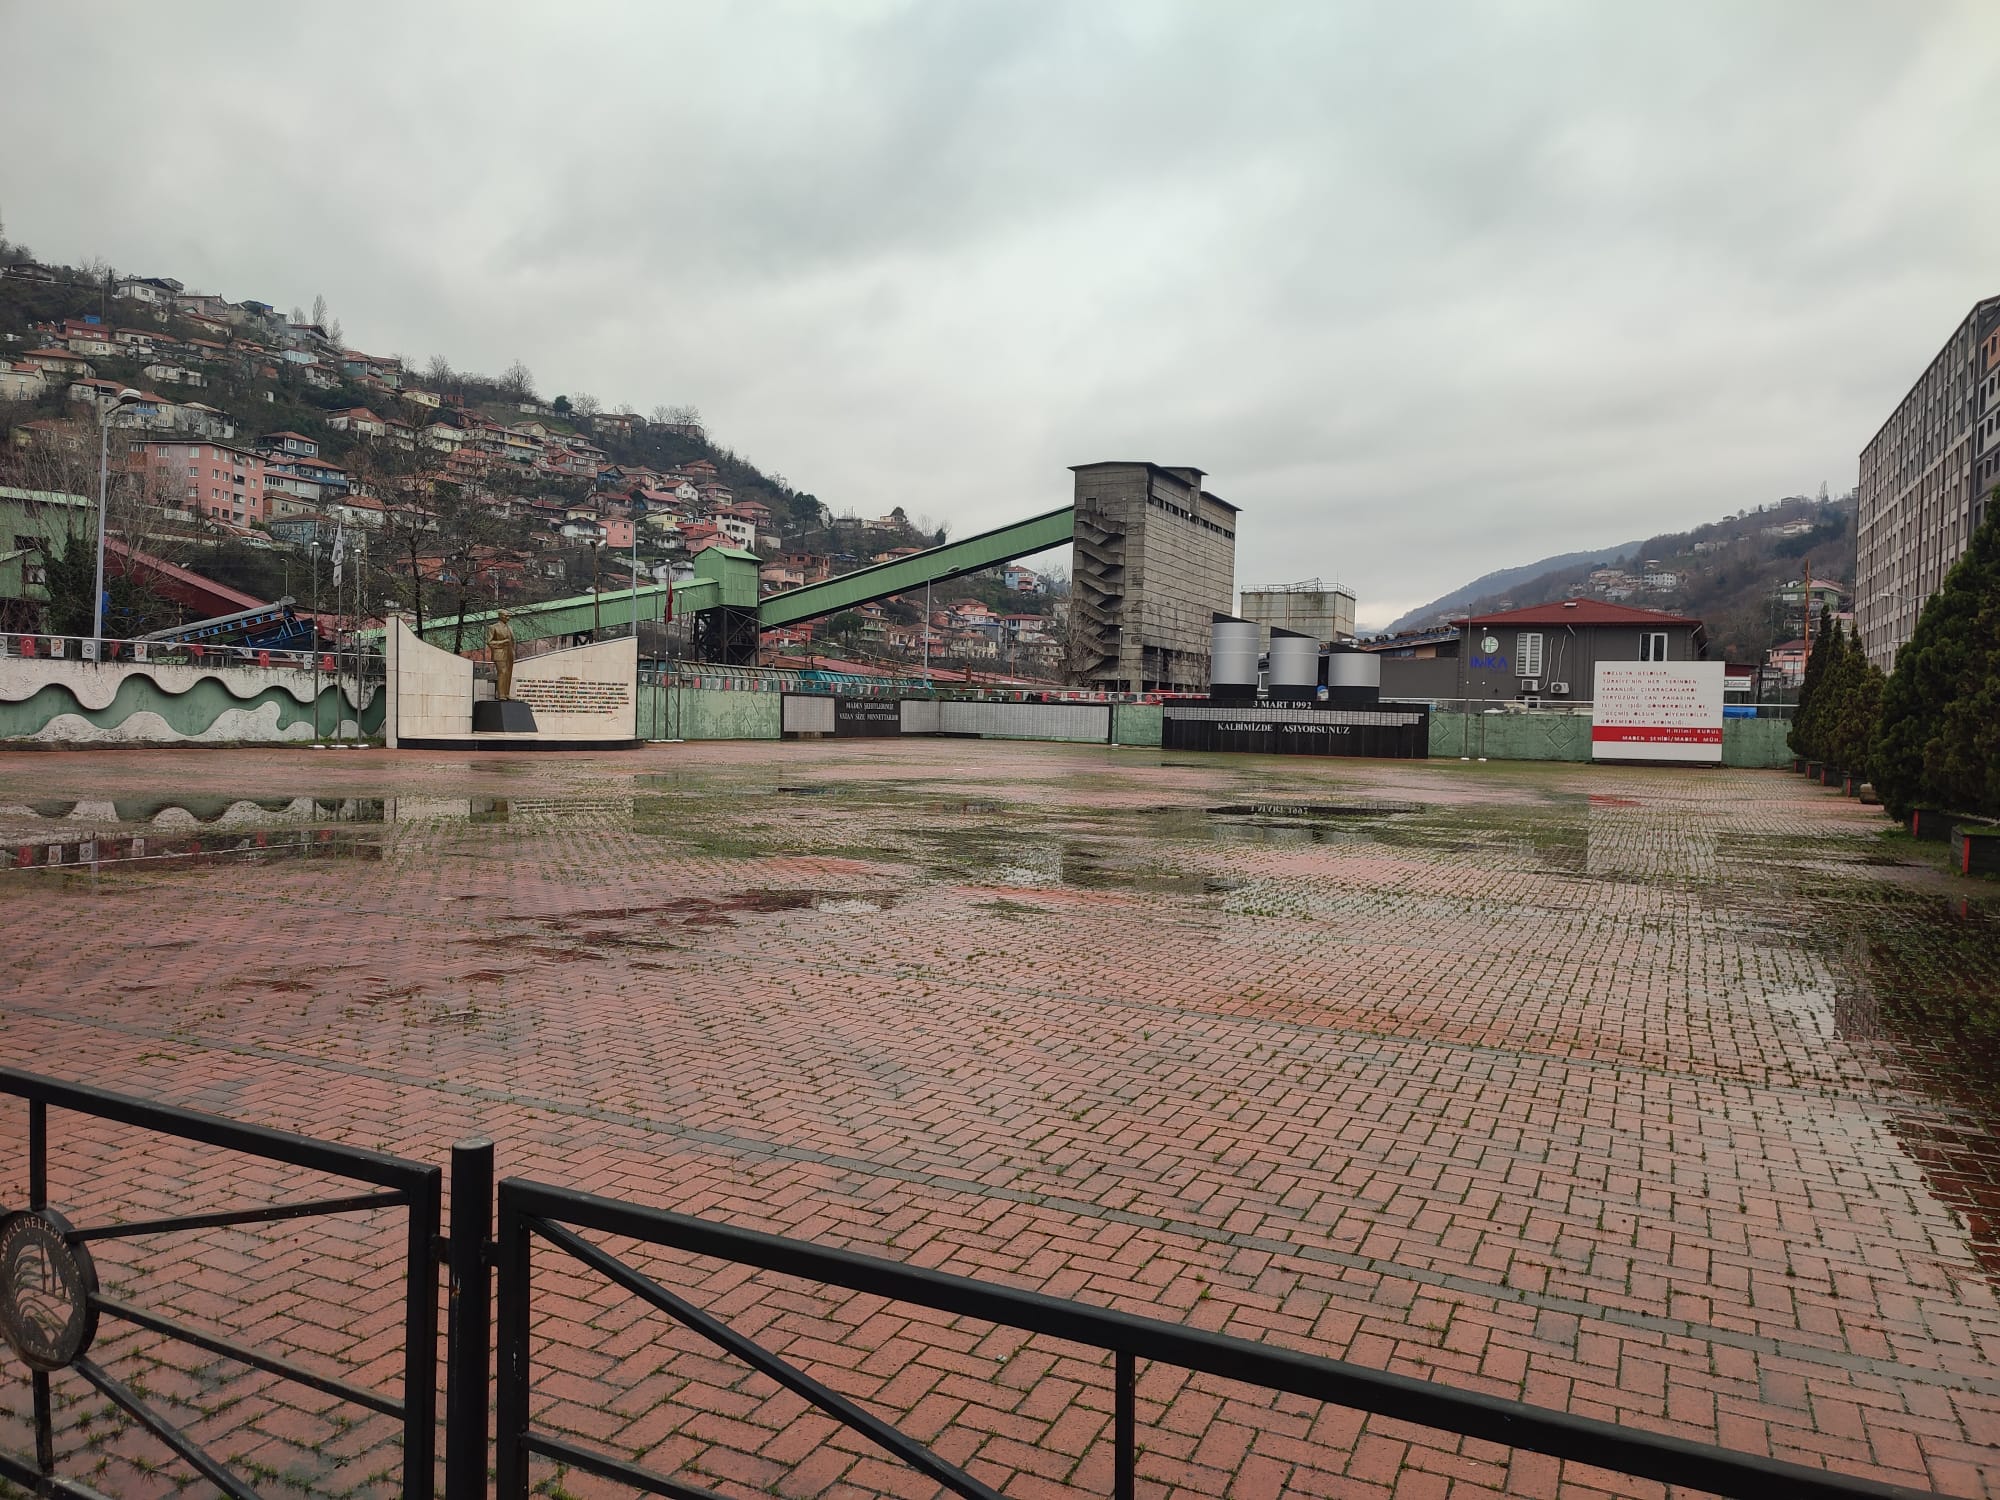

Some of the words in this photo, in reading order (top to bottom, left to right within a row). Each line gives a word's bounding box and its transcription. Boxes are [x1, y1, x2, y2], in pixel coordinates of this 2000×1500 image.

[1252, 700, 1258, 708] 3
[1261, 700, 1289, 709] MART
[1292, 701, 1312, 710] 1992
[1217, 722, 1274, 732] KALBİMİZDE
[1282, 724, 1351, 735] AŞIYORSUNUZ
